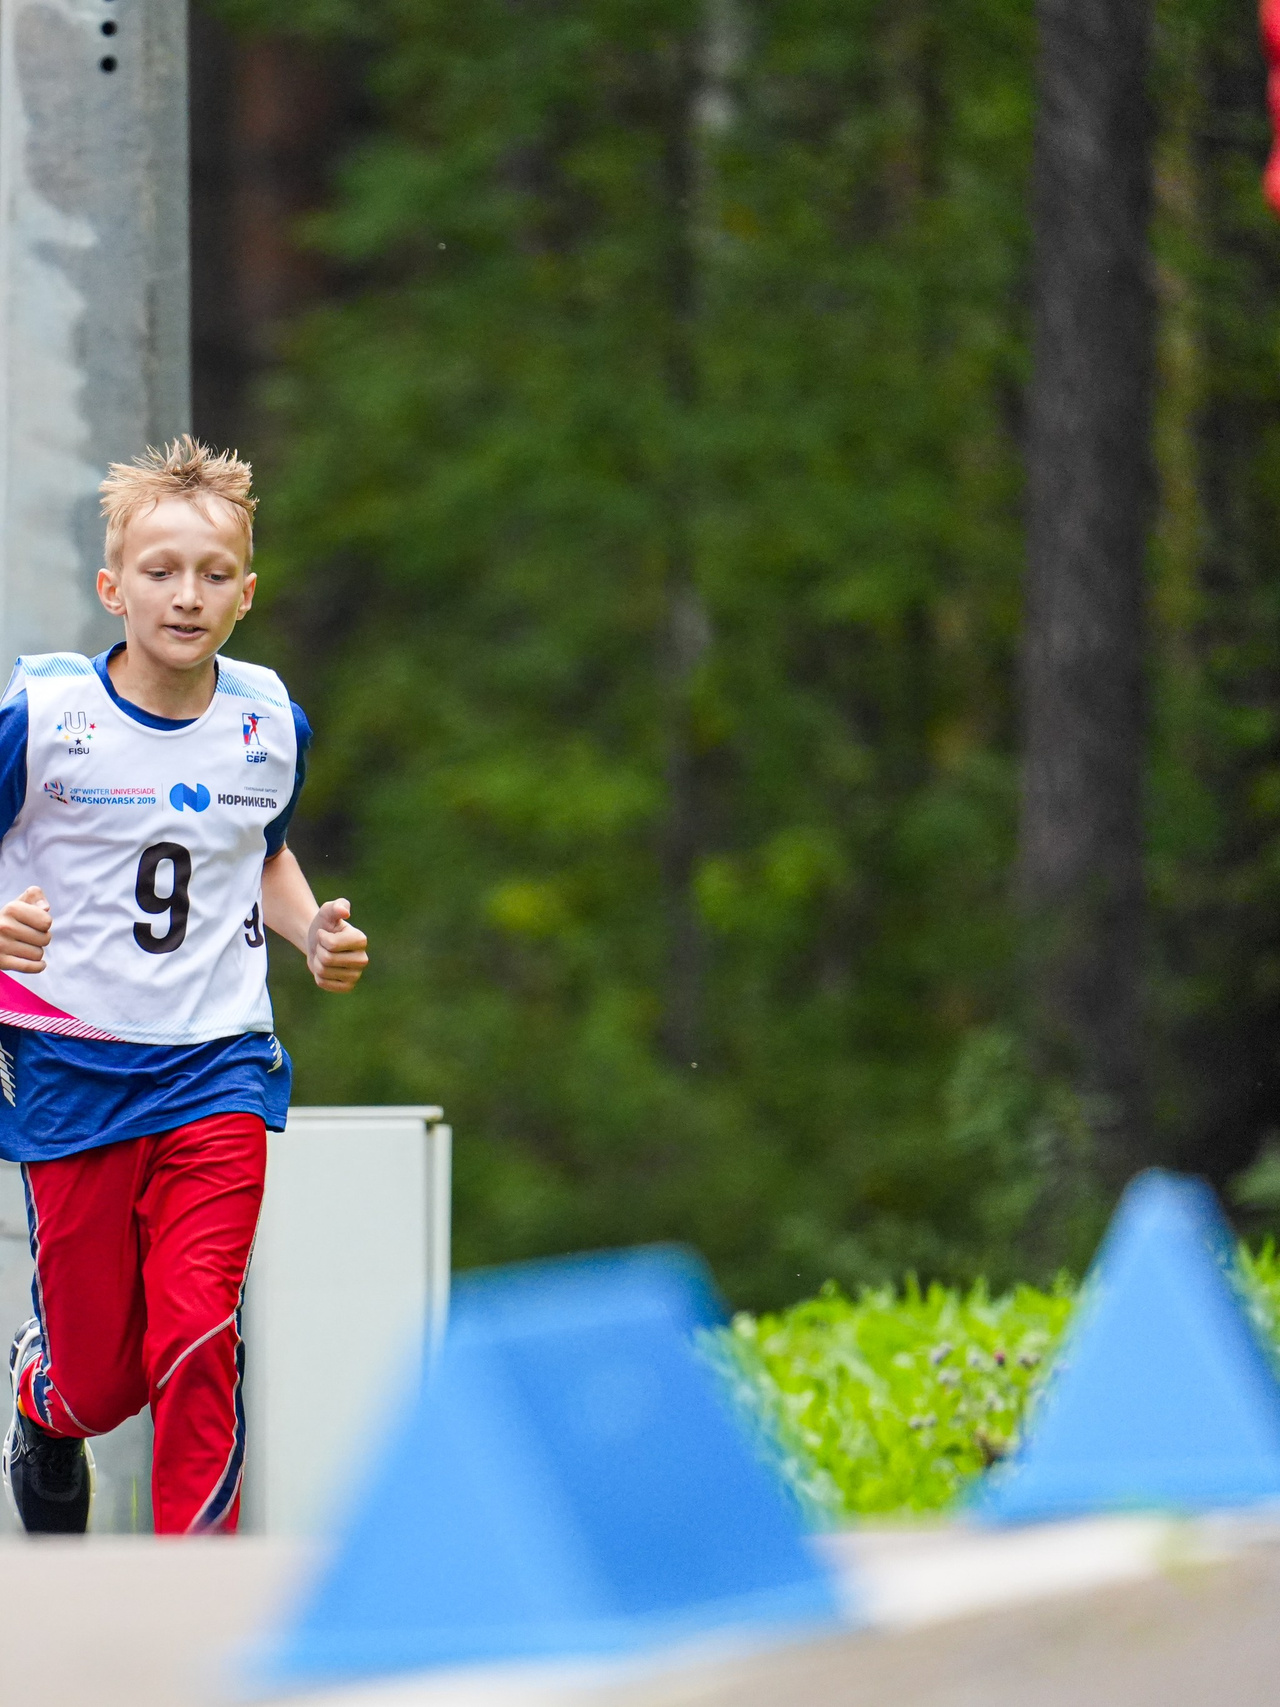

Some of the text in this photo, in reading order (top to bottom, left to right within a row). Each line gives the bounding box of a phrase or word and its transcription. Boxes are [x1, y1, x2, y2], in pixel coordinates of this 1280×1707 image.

[68, 747, 90, 755] FISU
[246, 755, 267, 763] СБР
[70, 795, 135, 805] KRASNOYARSK
[218, 793, 277, 809] НОРНИКЕЛЬ
[133, 841, 192, 954] 9
